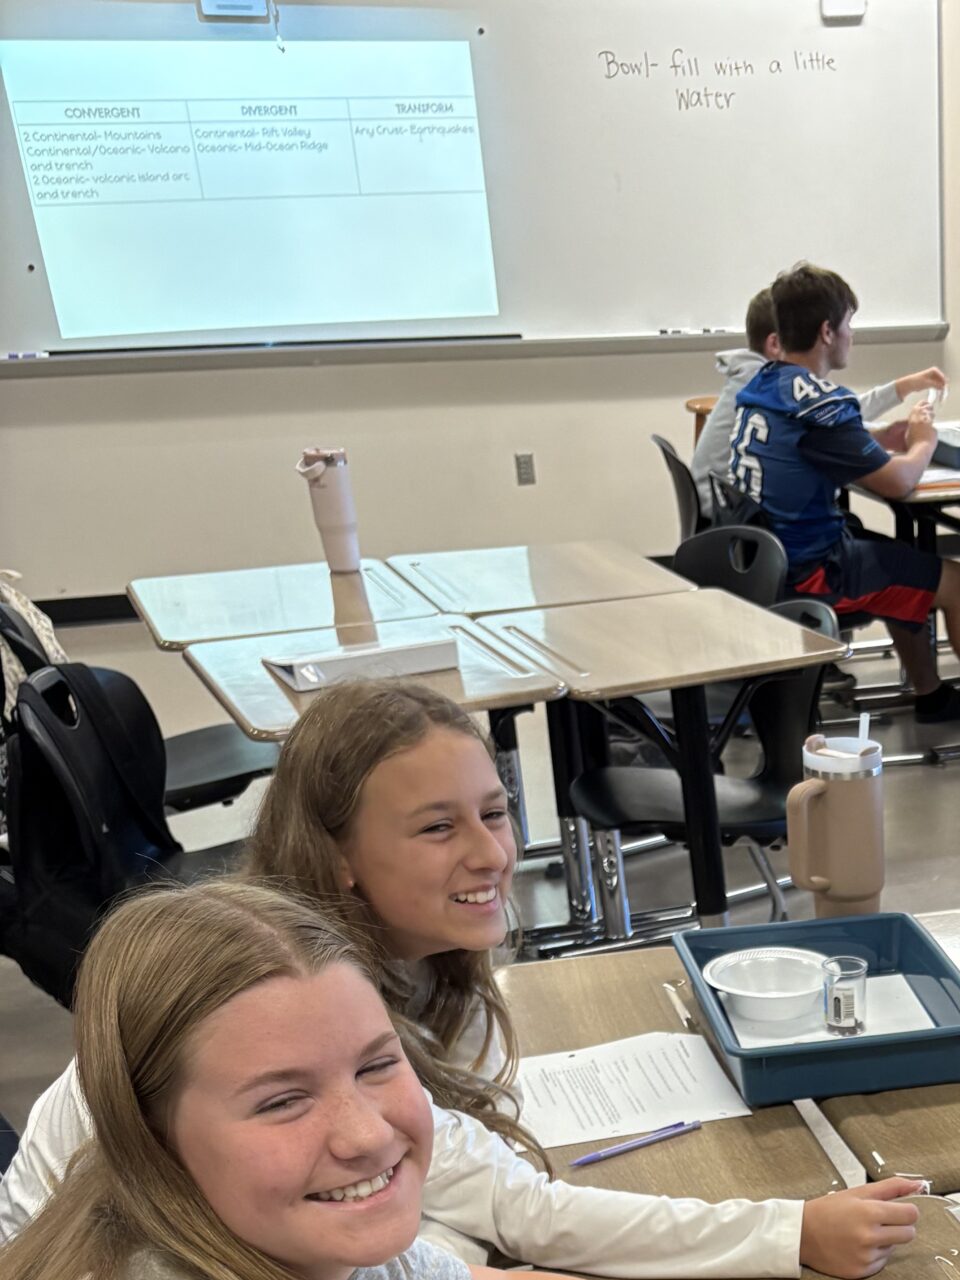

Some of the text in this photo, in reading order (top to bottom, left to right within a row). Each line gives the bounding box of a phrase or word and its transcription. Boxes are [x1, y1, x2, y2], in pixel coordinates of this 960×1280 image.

[670, 48, 700, 77] fill
[714, 56, 754, 77] with
[768, 60, 782, 74] a
[794, 50, 837, 72] little
[64, 107, 141, 119] CONVERGENT
[240, 105, 298, 116] DIVERGENT
[23, 130, 162, 142] 2 Continental- Mountains
[282, 126, 311, 139] Valley
[355, 126, 375, 138] Any
[300, 140, 328, 153] Ridge
[31, 160, 93, 171] and trench
[33, 176, 40, 186] 2
[92, 173, 136, 183] volcanic
[172, 173, 190, 182] arc
[36, 188, 100, 200] and trench
